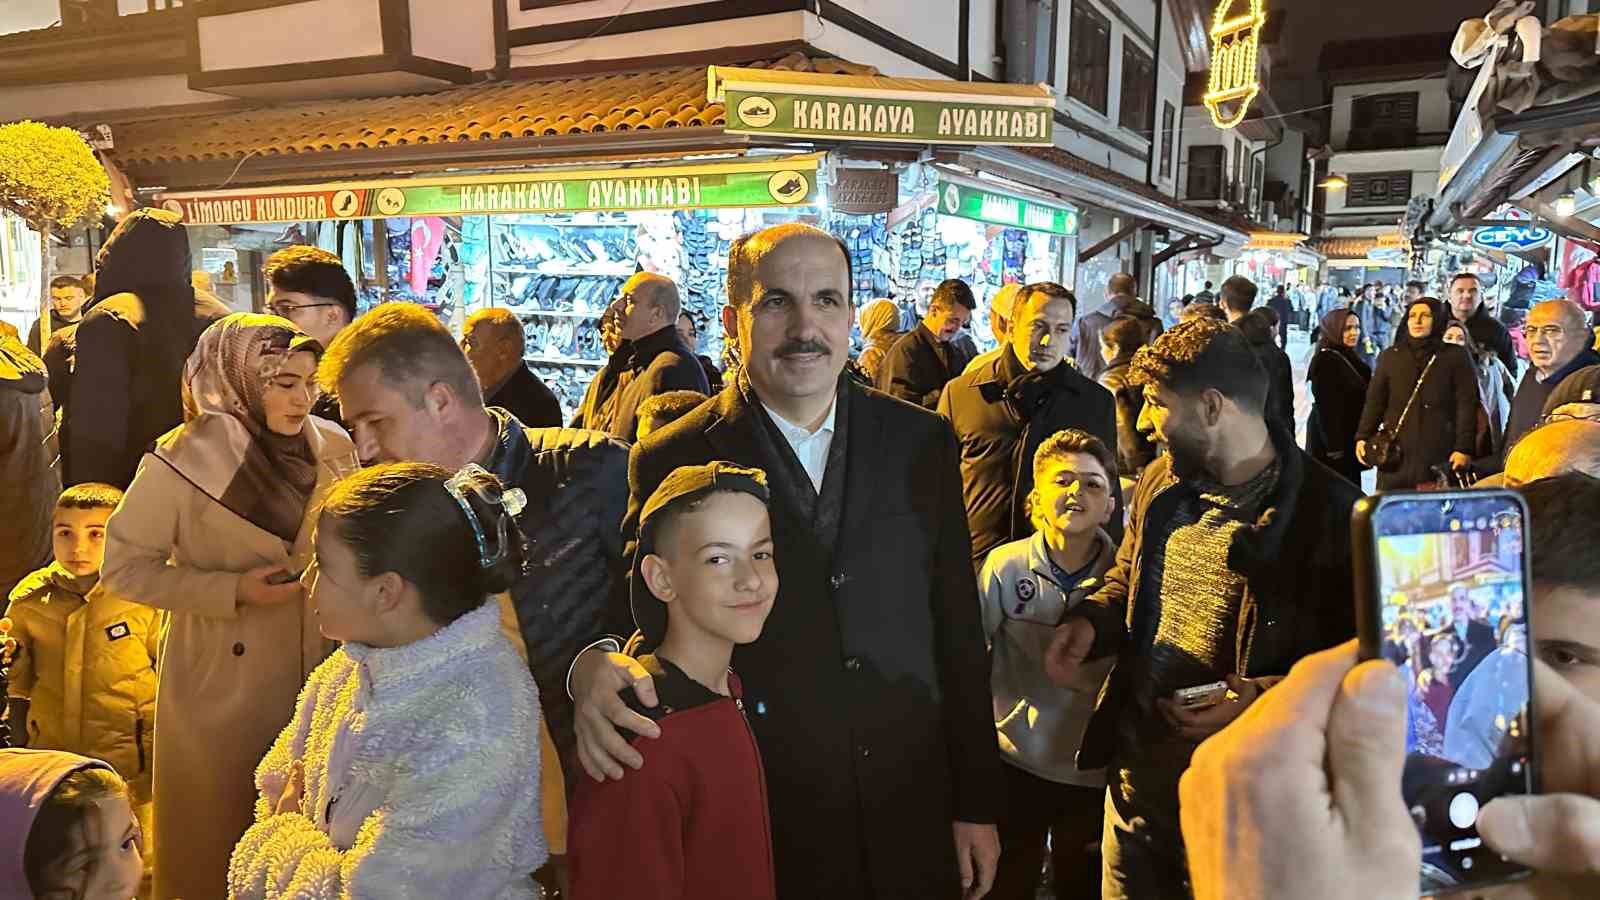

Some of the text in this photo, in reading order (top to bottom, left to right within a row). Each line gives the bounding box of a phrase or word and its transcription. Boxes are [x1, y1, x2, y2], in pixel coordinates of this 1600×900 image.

[793, 100, 1047, 138] KARAKAYA AYAKKABI
[186, 195, 328, 224] LİMONCU KUNDURA
[460, 176, 701, 211] KARAKAYA AYAKKABI
